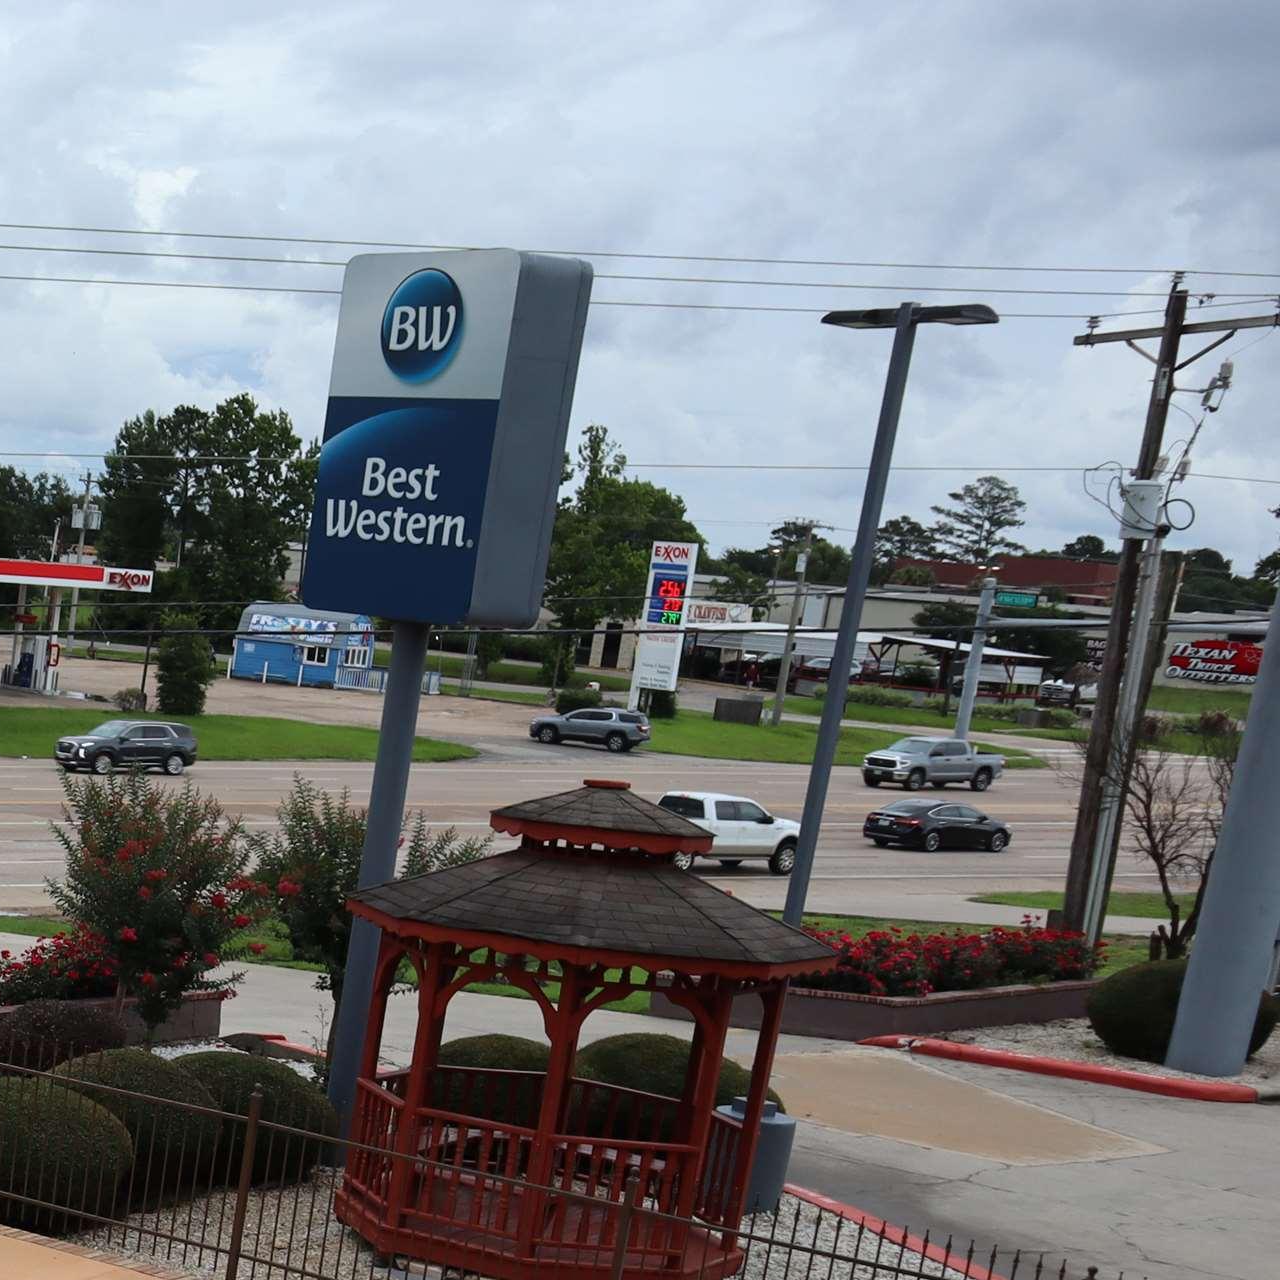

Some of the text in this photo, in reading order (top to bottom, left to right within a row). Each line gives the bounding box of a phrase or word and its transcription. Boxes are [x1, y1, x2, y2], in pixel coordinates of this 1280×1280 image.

[388, 303, 457, 352] BW
[361, 456, 441, 501] Best
[325, 498, 466, 548] Western
[654, 544, 689, 562] EXXON
[108, 571, 151, 590] EXXON
[1172, 642, 1237, 660] TEXAN
[1165, 665, 1257, 684] OUTFITTERS
[1187, 658, 1235, 673] TRUCK
